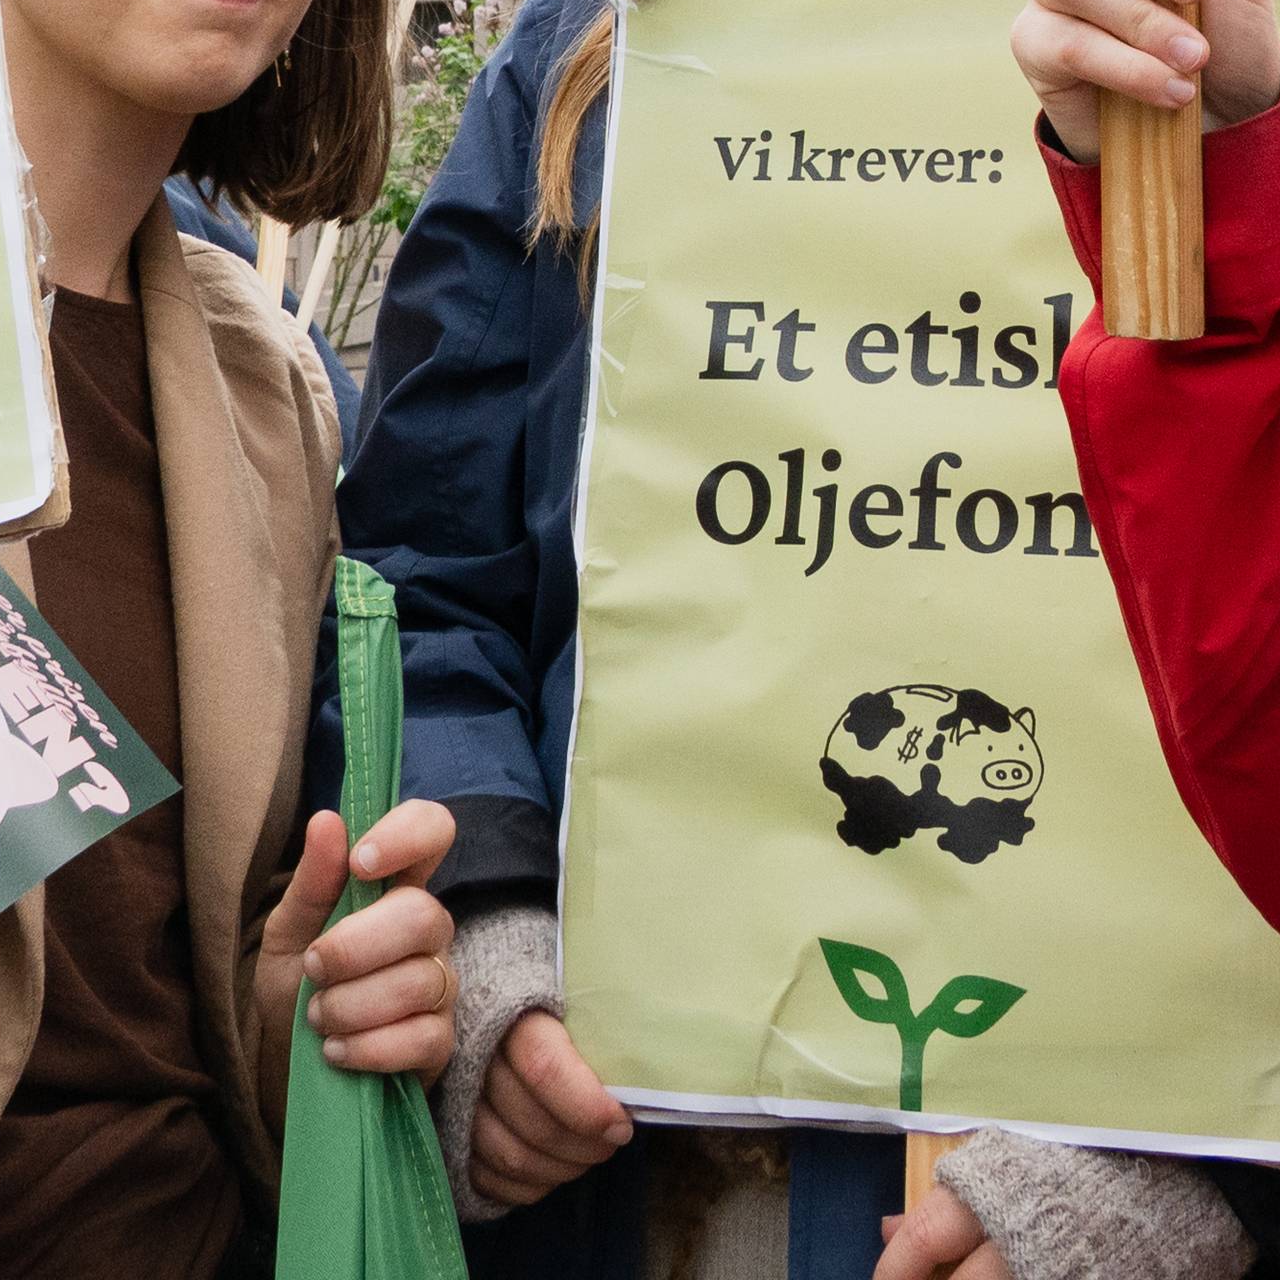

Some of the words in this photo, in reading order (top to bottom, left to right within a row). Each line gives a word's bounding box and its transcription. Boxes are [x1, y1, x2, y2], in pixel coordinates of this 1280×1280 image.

[714, 130, 772, 181] Vi
[787, 130, 1004, 183] krever:
[698, 301, 816, 381] Et
[695, 448, 1100, 577] Oljefon
